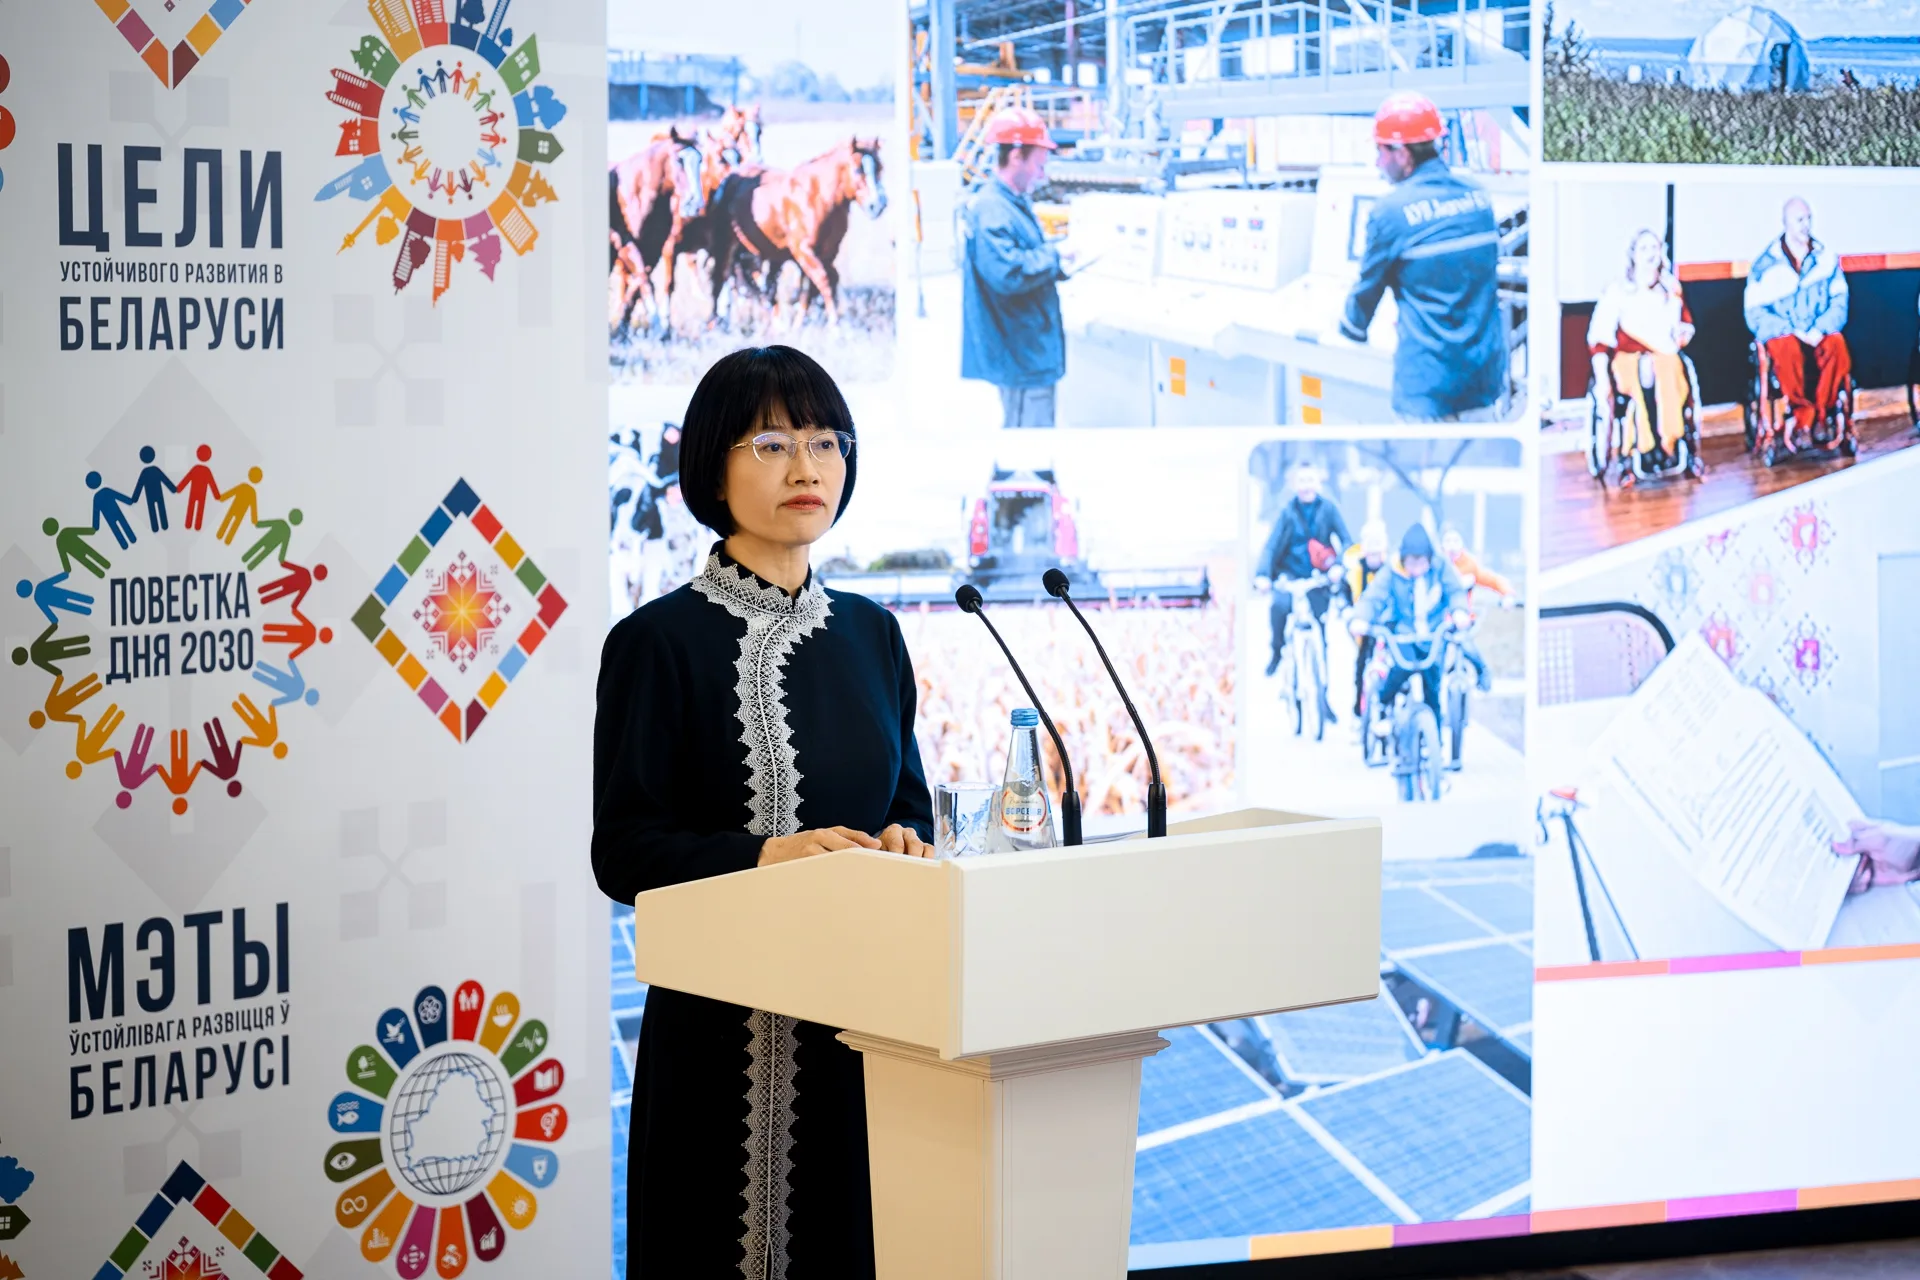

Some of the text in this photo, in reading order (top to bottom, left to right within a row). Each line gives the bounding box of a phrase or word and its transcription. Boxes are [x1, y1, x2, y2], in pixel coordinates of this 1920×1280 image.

[57, 142, 283, 253] ЦЕЛИ
[60, 257, 283, 284] УСТОЙЧИВОГО РАЗВИТИЯ В
[59, 296, 284, 351] БЕЛАРУСИ
[110, 572, 251, 627] ПОВЕСТКА
[105, 627, 254, 686] ДНЯ 2030
[67, 902, 290, 1025] МЭТЫ
[69, 999, 290, 1057] ЎСТОЙЛІВАГА РАЗВІЦЦЯ Ў
[69, 1034, 290, 1121] БЕЛАРУСІ
